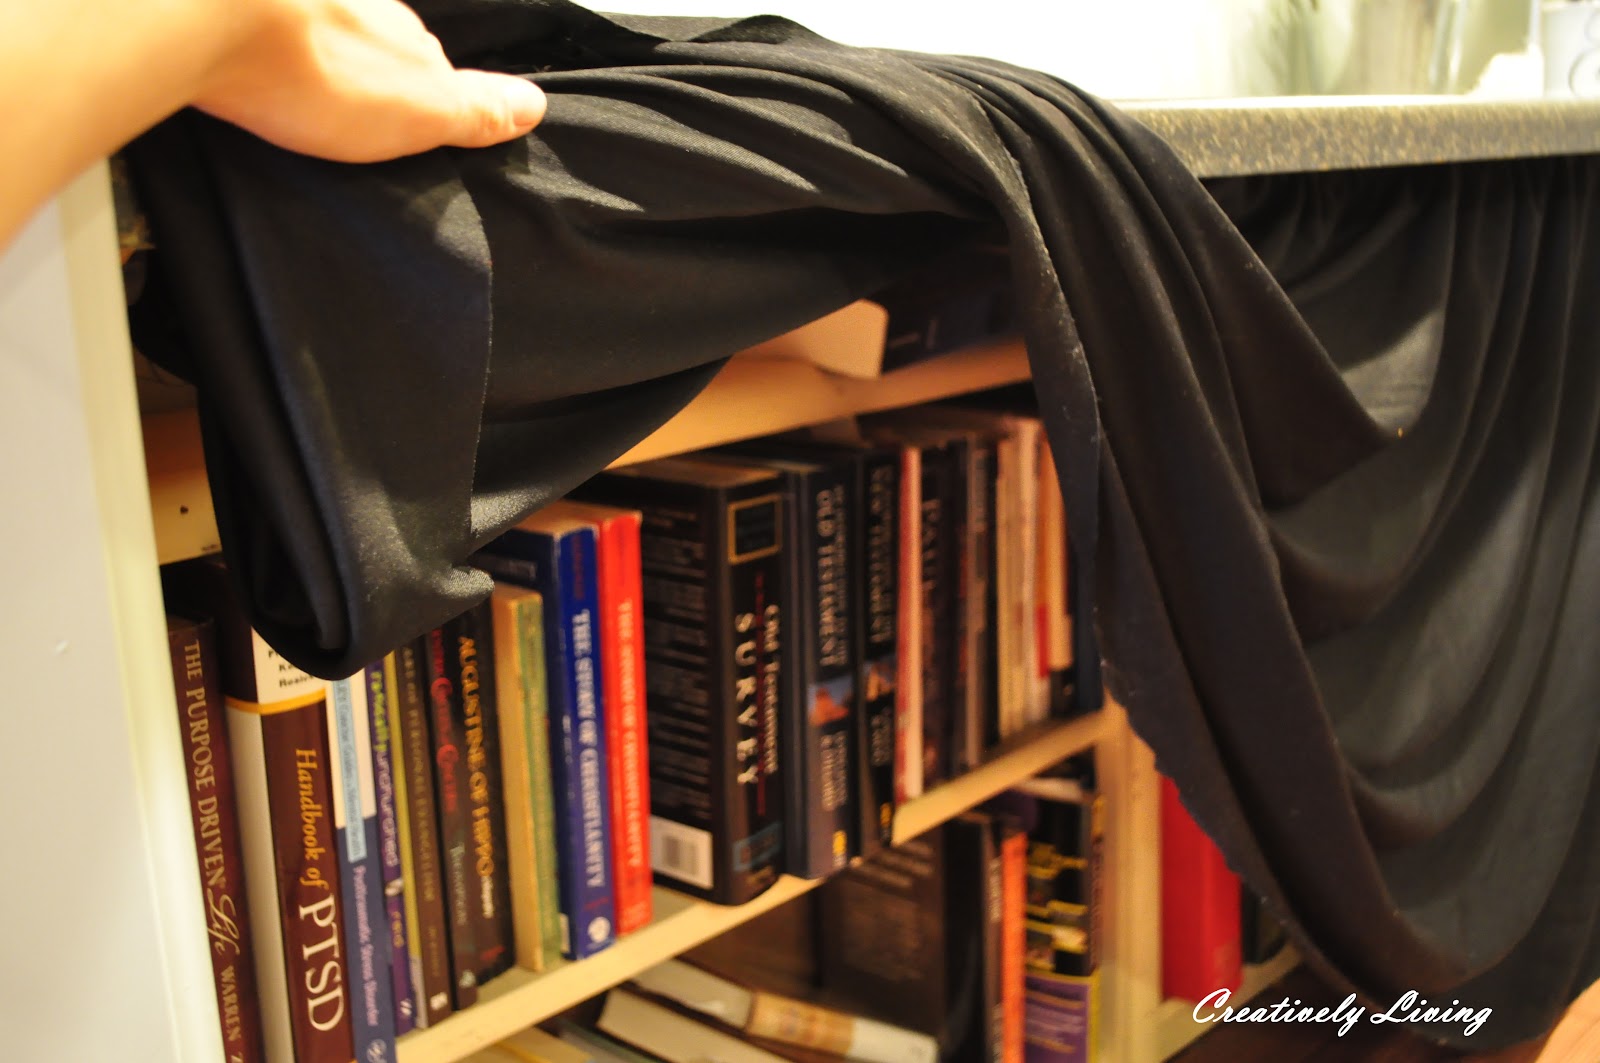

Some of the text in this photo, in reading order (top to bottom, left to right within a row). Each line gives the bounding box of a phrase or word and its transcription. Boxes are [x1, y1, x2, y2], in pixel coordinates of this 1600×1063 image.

[573, 610, 591, 655] THE
[734, 612, 758, 785] SURVEY
[458, 637, 485, 770] AUGUSTINE
[185, 639, 240, 955] THE PURPOSE DRIVEN Life
[296, 749, 328, 890] Handbook of
[221, 965, 241, 1041] WARREN
[299, 893, 344, 1032] PTSD
